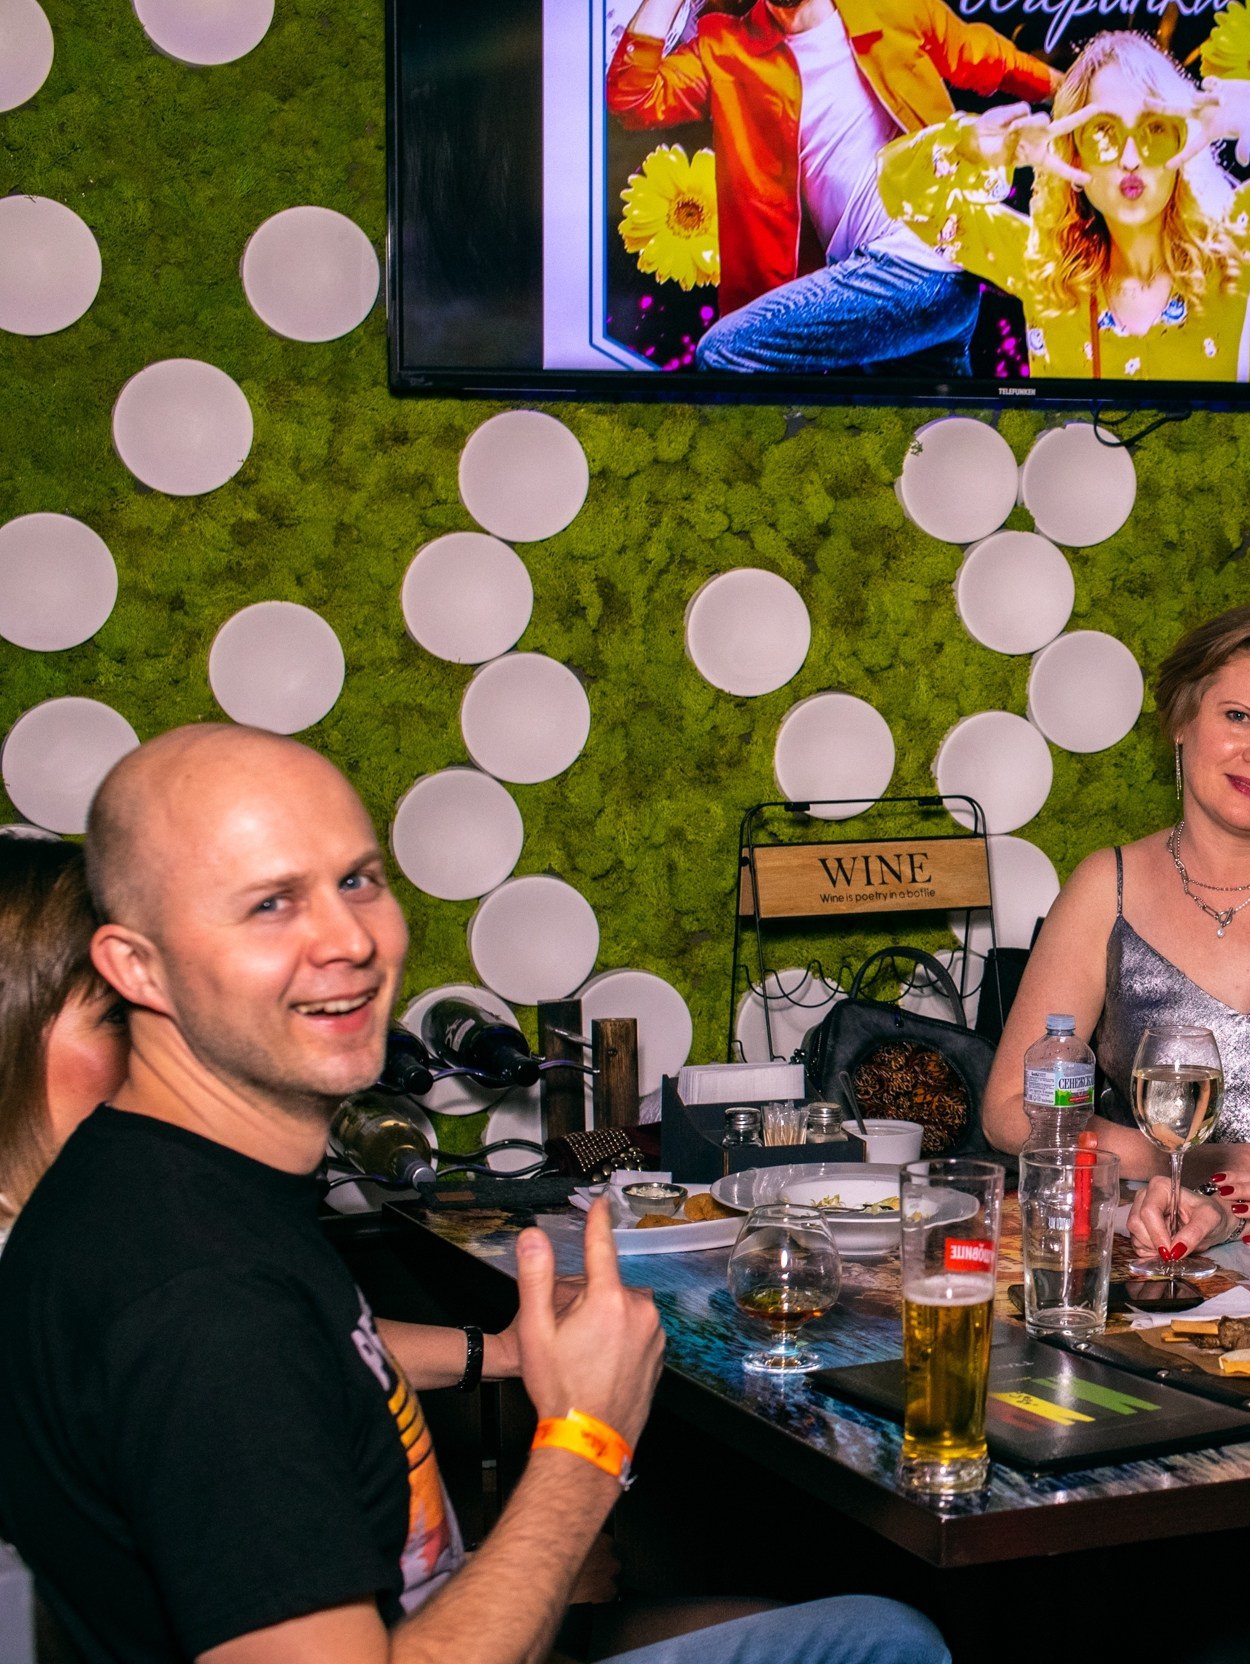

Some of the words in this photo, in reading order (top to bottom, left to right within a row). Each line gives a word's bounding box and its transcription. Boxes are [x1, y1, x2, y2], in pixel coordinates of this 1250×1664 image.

[998, 387, 1036, 396] TELEFUNKEN
[818, 853, 931, 887] WINE
[820, 893, 845, 903] Wine
[846, 892, 853, 901] is
[855, 891, 887, 903] poetry
